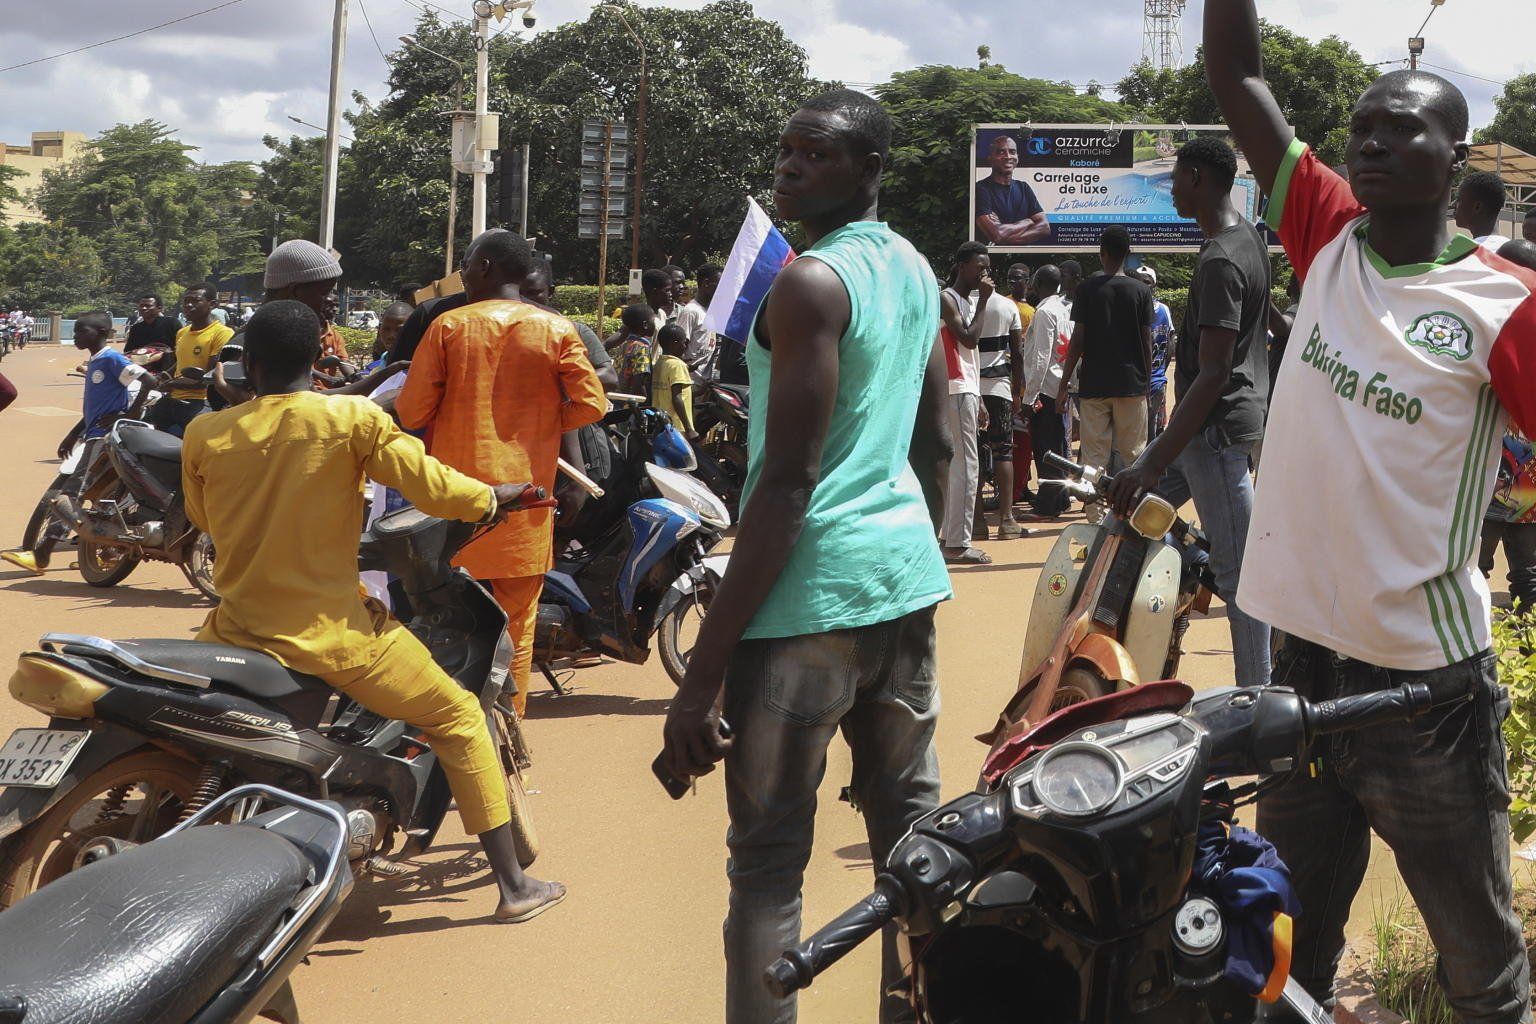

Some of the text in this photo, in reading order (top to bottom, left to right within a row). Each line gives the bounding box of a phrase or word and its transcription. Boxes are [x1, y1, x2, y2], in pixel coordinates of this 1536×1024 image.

[1033, 172, 1100, 185] Carrelage
[1059, 184, 1108, 194] de luxe
[1071, 196, 1099, 209] touche
[1362, 371, 1423, 425] Faso
[215, 655, 247, 665] YAMAHA
[28, 733, 55, 755] 11
[13, 758, 64, 783] 3537
